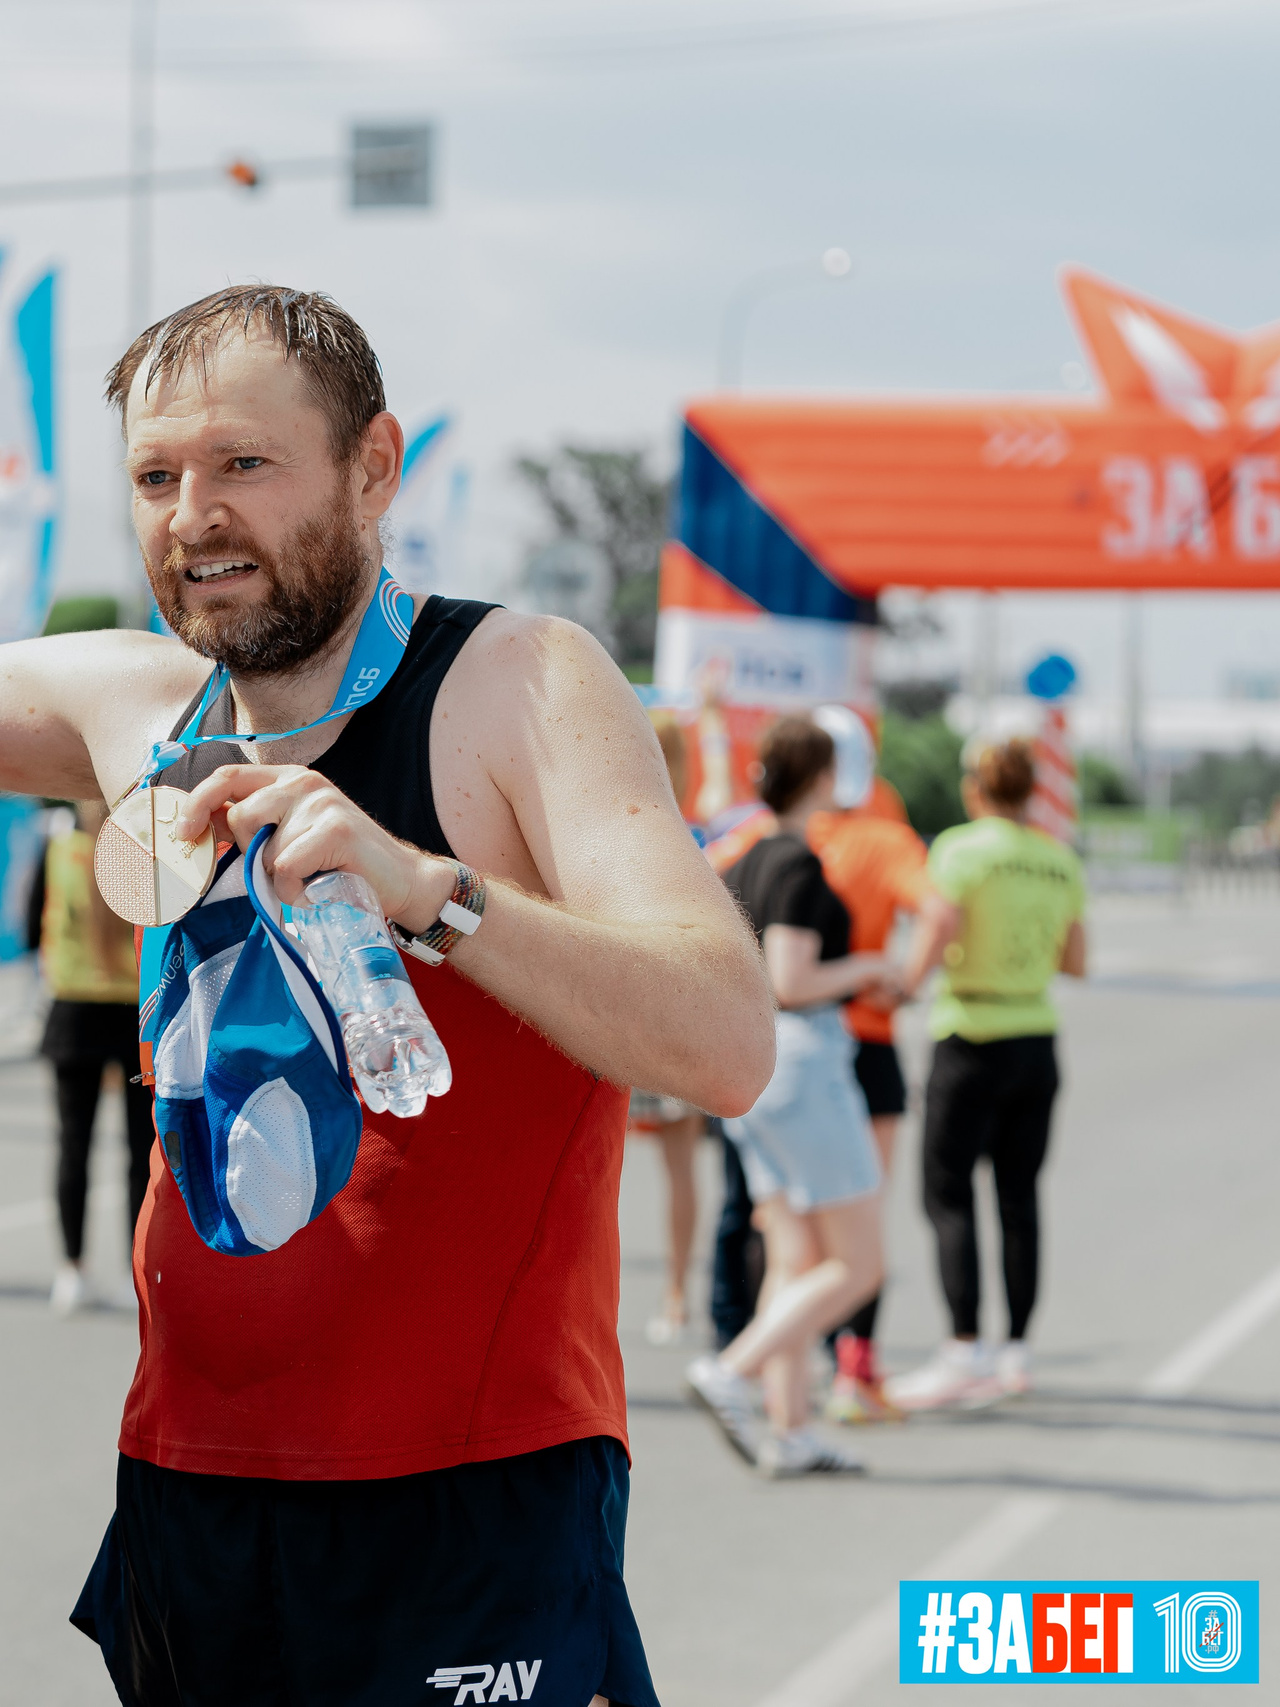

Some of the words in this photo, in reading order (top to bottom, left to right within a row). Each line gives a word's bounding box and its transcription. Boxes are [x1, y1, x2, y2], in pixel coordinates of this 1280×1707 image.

[1100, 457, 1217, 563] ЗА
[344, 667, 381, 707] ПСБ
[426, 1659, 542, 1706] RAY
